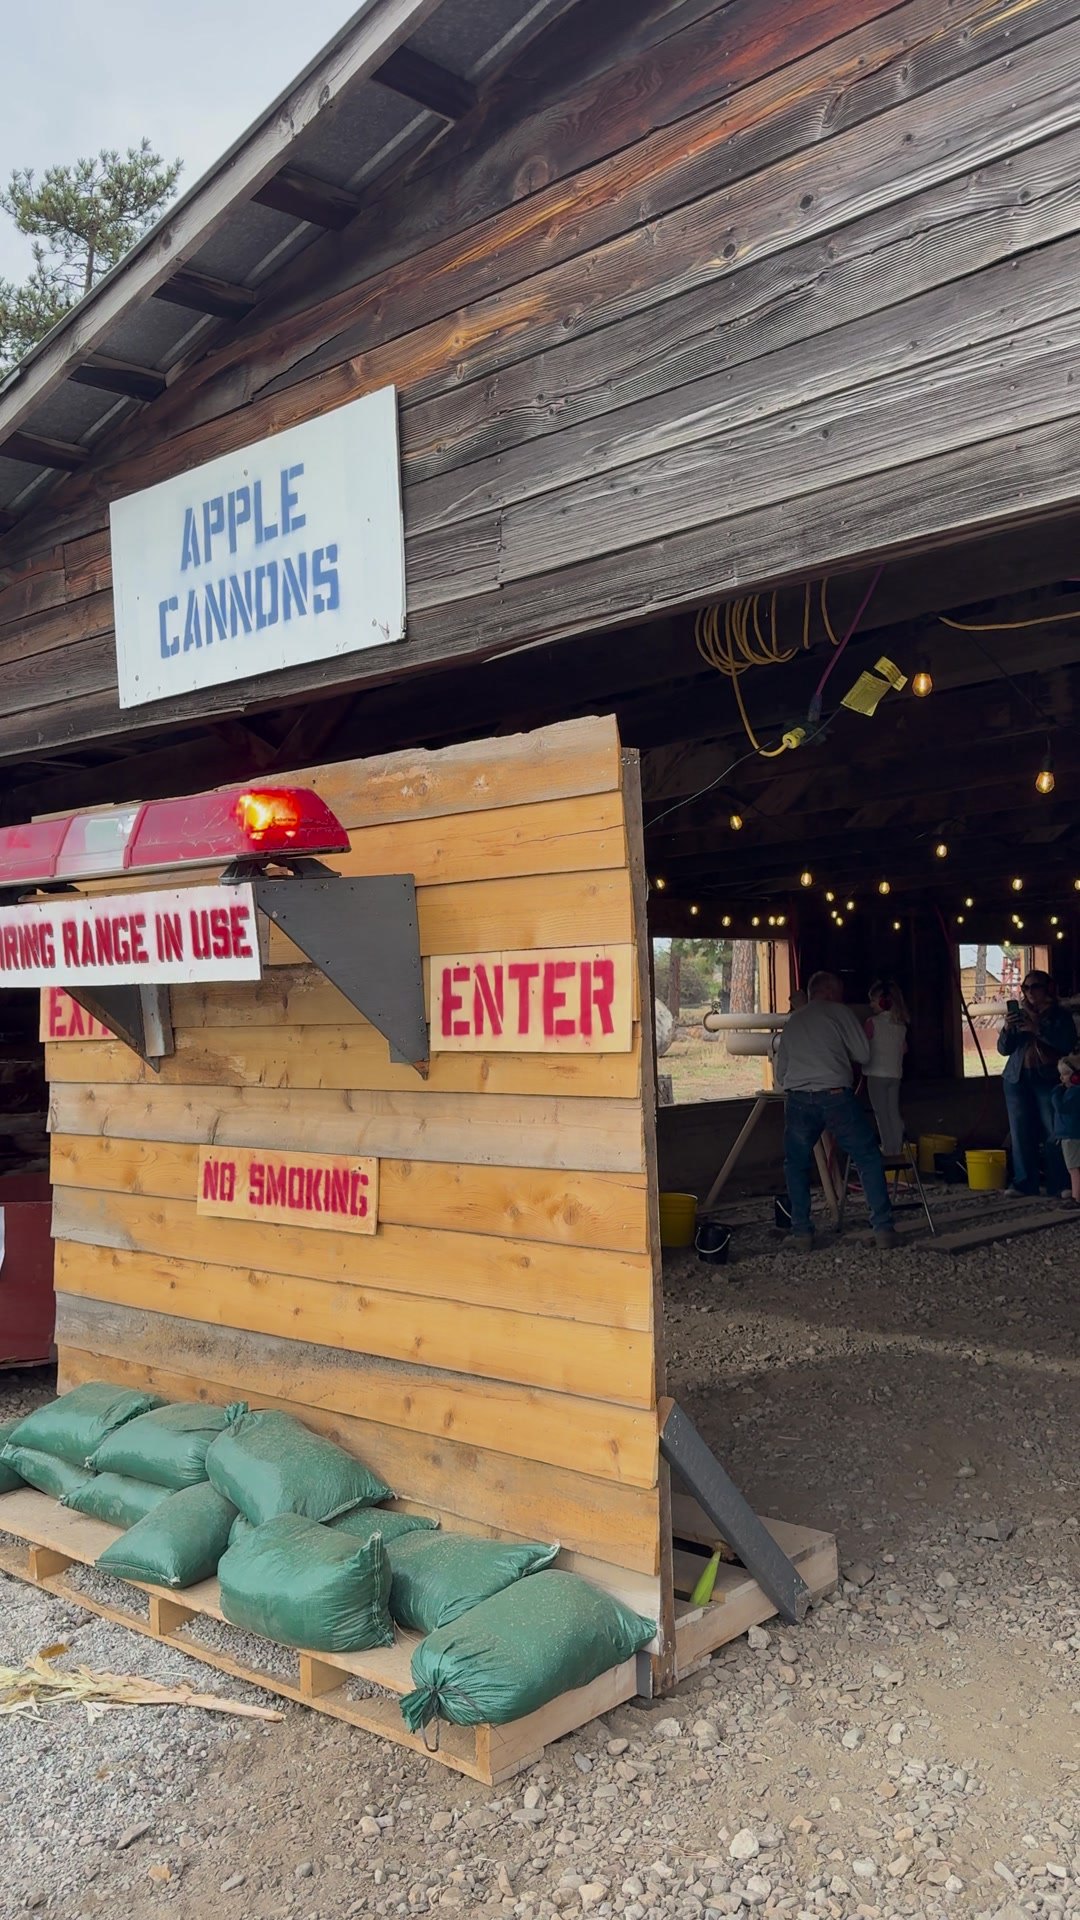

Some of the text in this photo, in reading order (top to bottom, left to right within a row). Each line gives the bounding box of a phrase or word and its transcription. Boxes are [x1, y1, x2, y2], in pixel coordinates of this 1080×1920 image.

[180, 462, 306, 571] APPLE
[158, 543, 340, 659] CANNONS
[62, 913, 149, 968] RANGE
[155, 911, 184, 963] IN
[190, 906, 253, 960] USE
[441, 959, 615, 1037] ENTER
[203, 1160, 369, 1217] NO SMOKING
